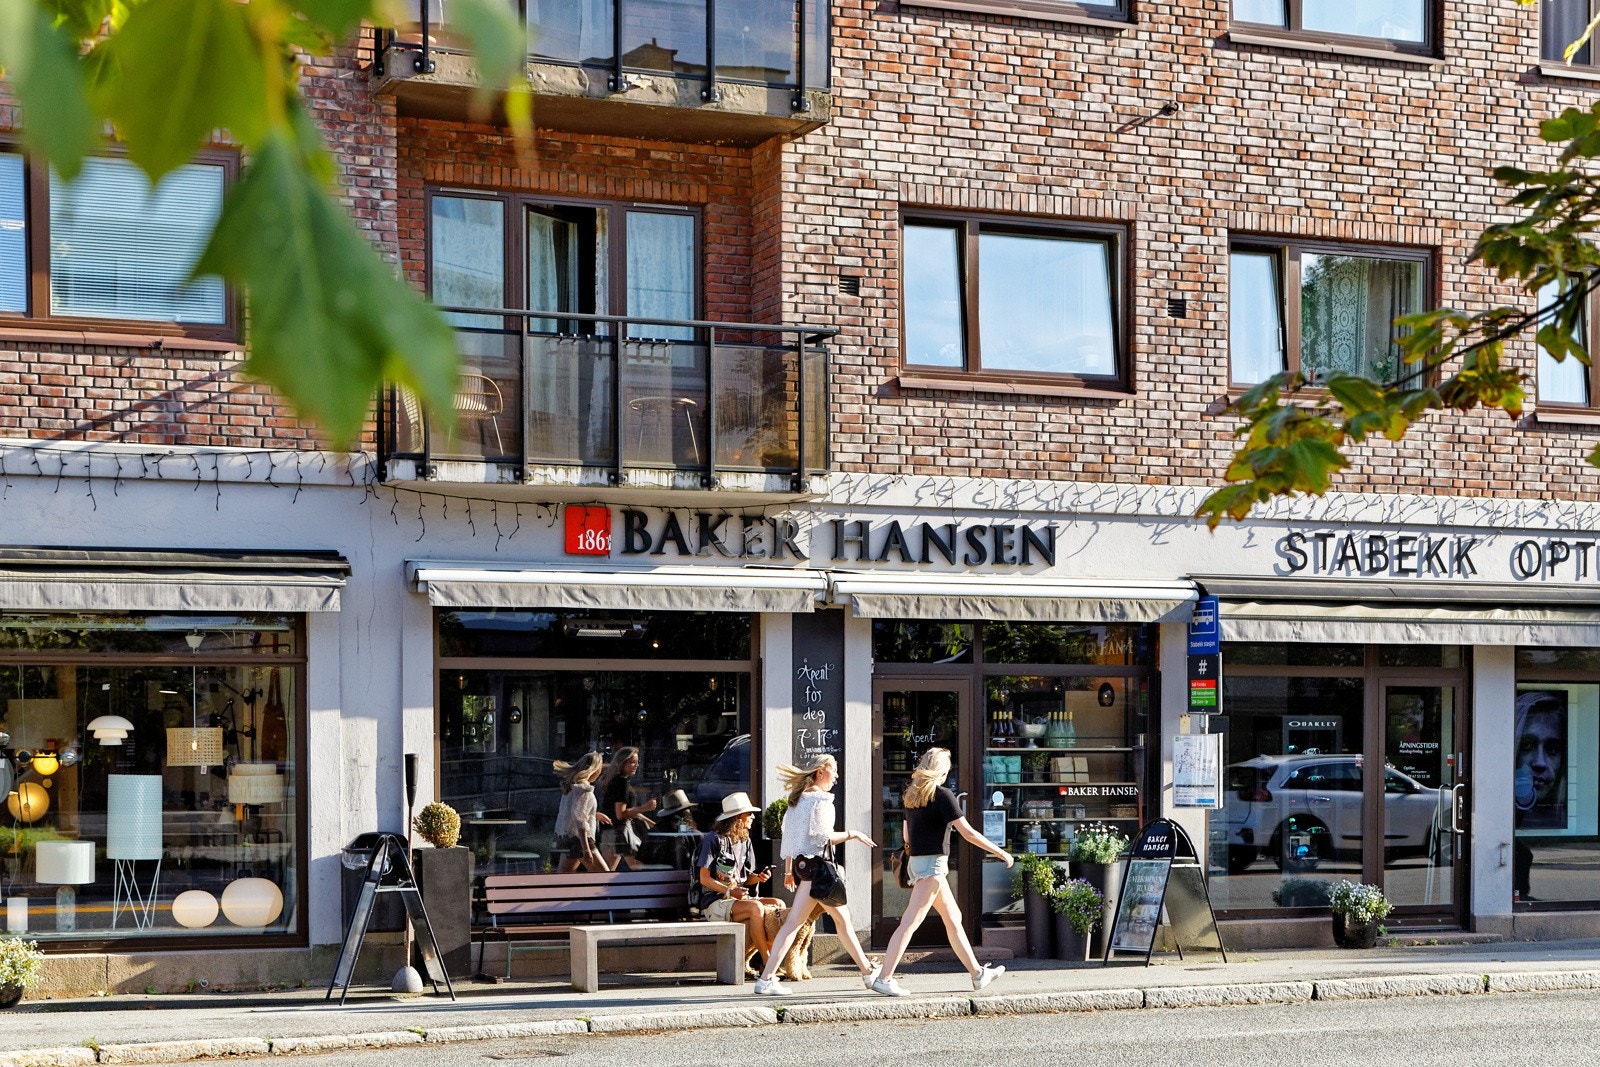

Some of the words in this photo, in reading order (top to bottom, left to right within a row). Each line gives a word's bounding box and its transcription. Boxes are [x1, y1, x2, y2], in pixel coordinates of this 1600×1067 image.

[620, 510, 811, 560] BAKER
[830, 518, 1060, 567] HANSEN
[1286, 532, 1478, 576] STABEKK
[801, 685, 823, 706] for
[802, 706, 826, 724] deg
[1399, 741, 1439, 749] ÅPNINGSTIDER
[1068, 786, 1099, 796] BAKER
